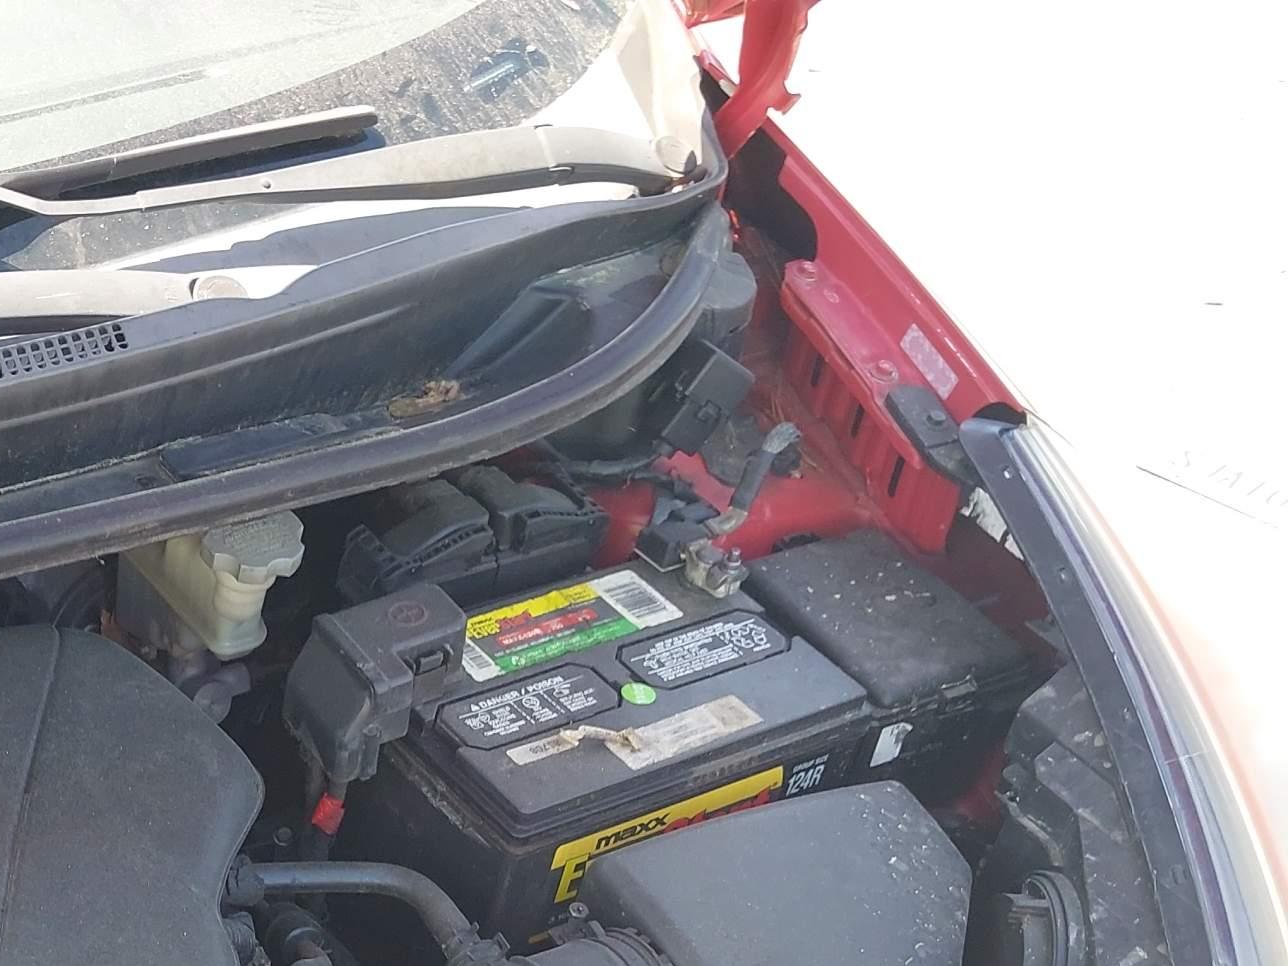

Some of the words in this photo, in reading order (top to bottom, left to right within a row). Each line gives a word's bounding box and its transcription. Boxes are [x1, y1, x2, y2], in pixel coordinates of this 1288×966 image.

[478, 690, 520, 708] DANGER
[527, 676, 563, 692] POISON
[785, 763, 826, 798] 124R
[595, 811, 671, 851] maxx
